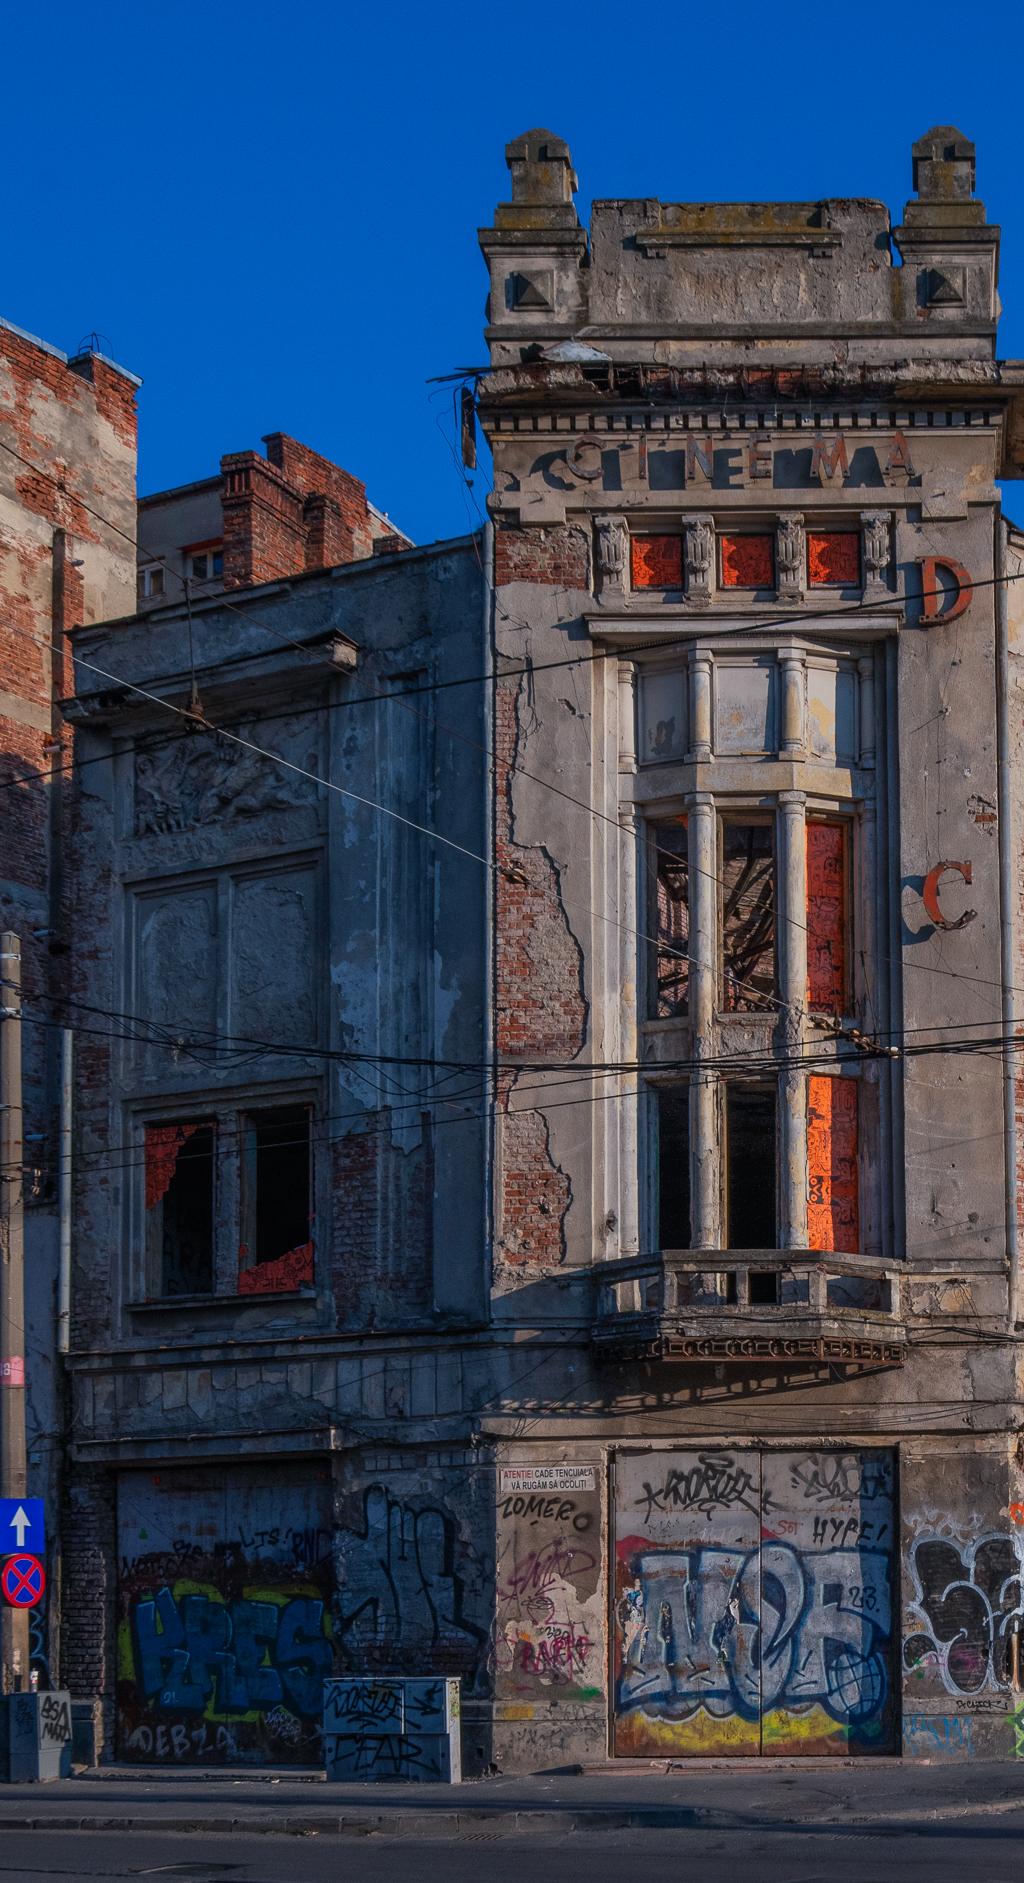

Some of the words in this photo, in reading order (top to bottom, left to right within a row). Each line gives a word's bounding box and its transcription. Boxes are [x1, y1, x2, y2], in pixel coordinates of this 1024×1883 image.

[566, 431, 915, 480] CINEMA
[916, 556, 973, 626] D
[923, 860, 978, 931] C
[535, 1469, 554, 1478] CADE
[555, 1467, 593, 1477] TENCUIALA
